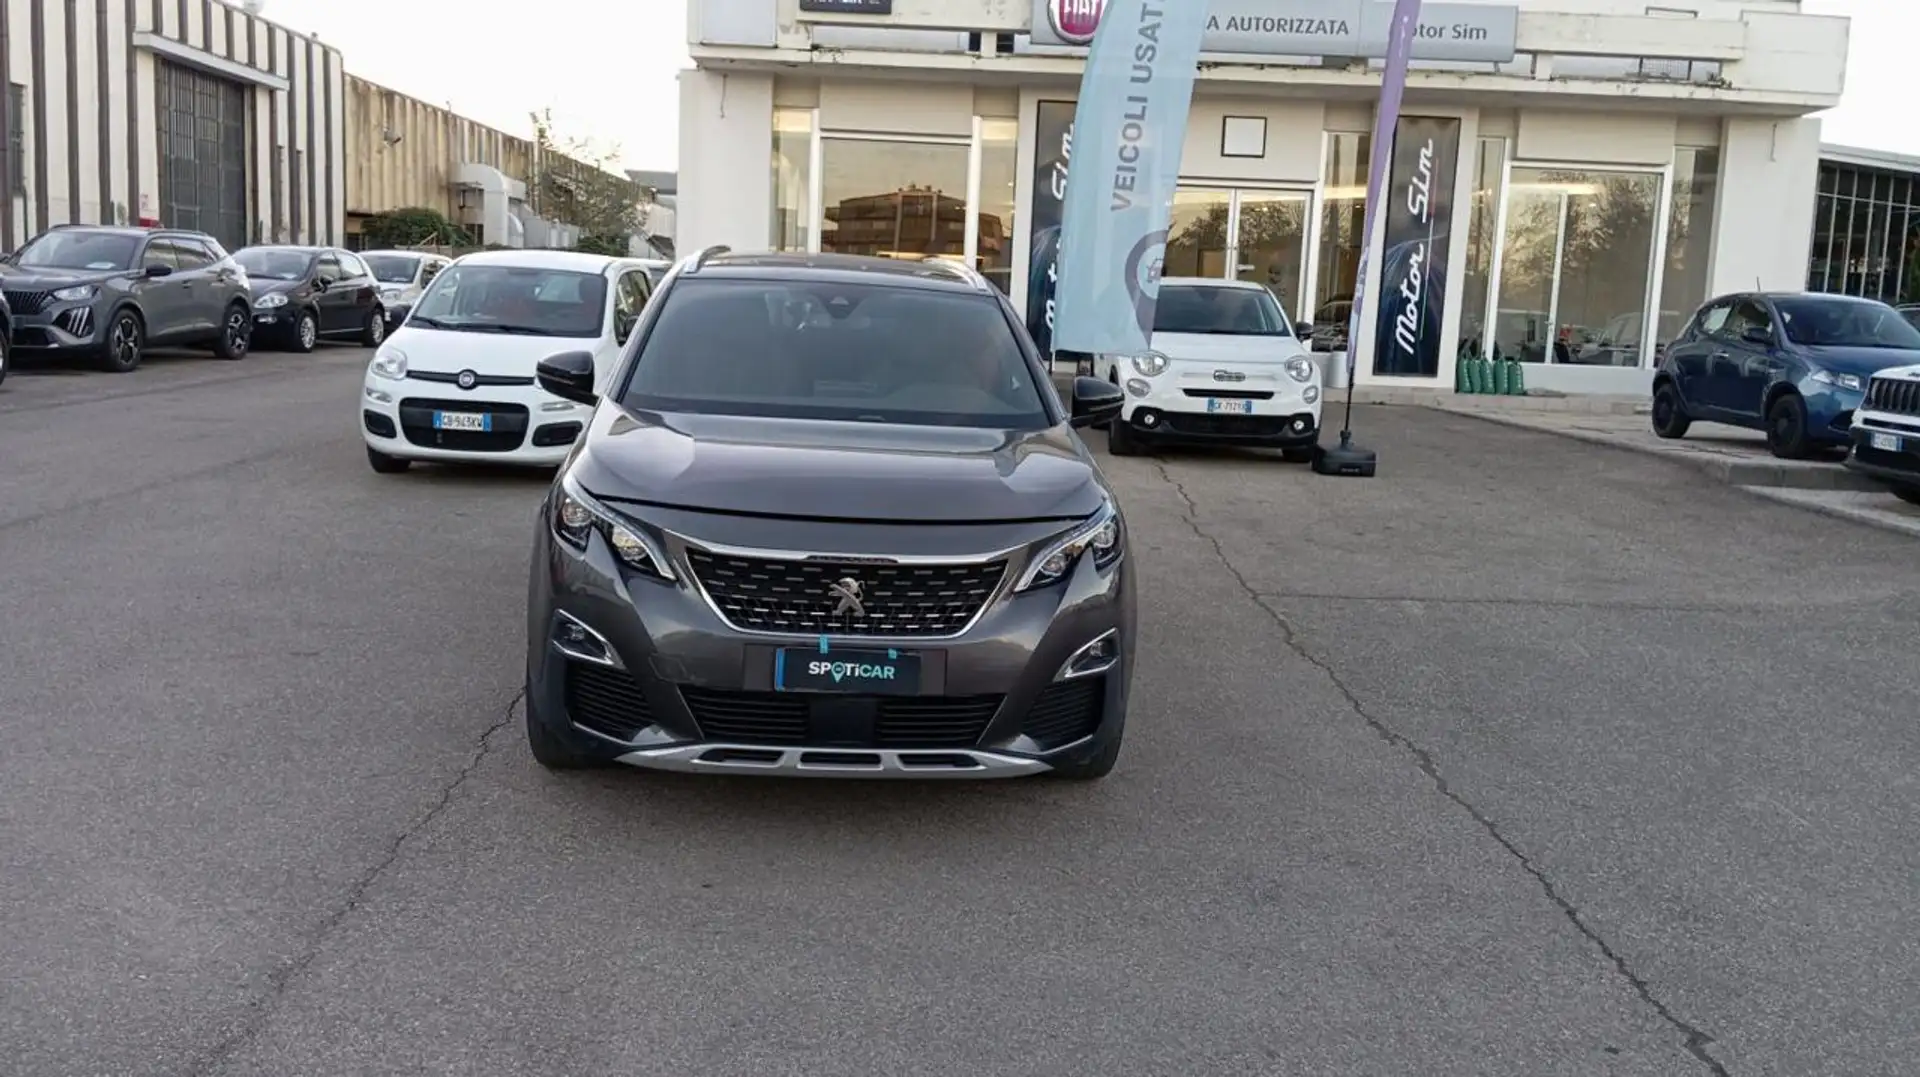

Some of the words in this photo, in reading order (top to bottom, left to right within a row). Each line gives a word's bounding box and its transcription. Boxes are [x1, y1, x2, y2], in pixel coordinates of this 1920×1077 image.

[1226, 16, 1349, 35] AUTORIZZATA
[1451, 25, 1488, 40] Sim
[1110, 95, 1148, 212] VEICOLI
[1130, 0, 1166, 84] USAT
[1407, 138, 1434, 224] Sim
[1395, 243, 1424, 355] Motor
